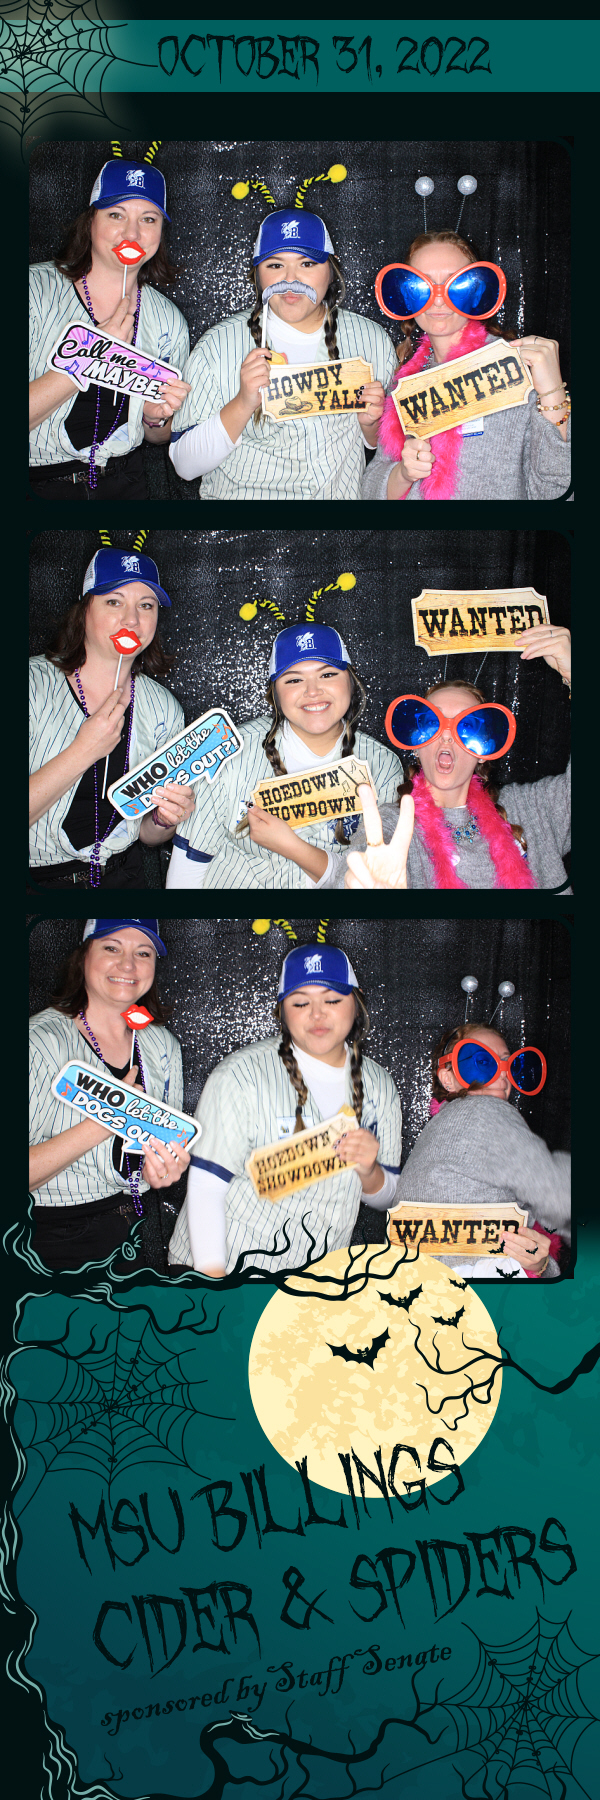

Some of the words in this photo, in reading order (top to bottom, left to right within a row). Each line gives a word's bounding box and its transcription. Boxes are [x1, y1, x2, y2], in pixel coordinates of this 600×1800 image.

[57, 339, 113, 359] Call
[109, 353, 137, 369] me
[267, 363, 342, 401] HOWDY
[400, 356, 525, 424] WANTED
[120, 763, 168, 799] WHO
[166, 745, 191, 768] let
[184, 728, 211, 750] the
[190, 736, 240, 775] OUT?!
[259, 769, 340, 807] HOEDOWN
[71, 1090, 127, 1129] DOGS
[76, 1072, 126, 1108] WHO
[125, 1099, 151, 1121] let
[151, 1109, 178, 1130] the
[256, 1130, 331, 1175] HOEDOWN
